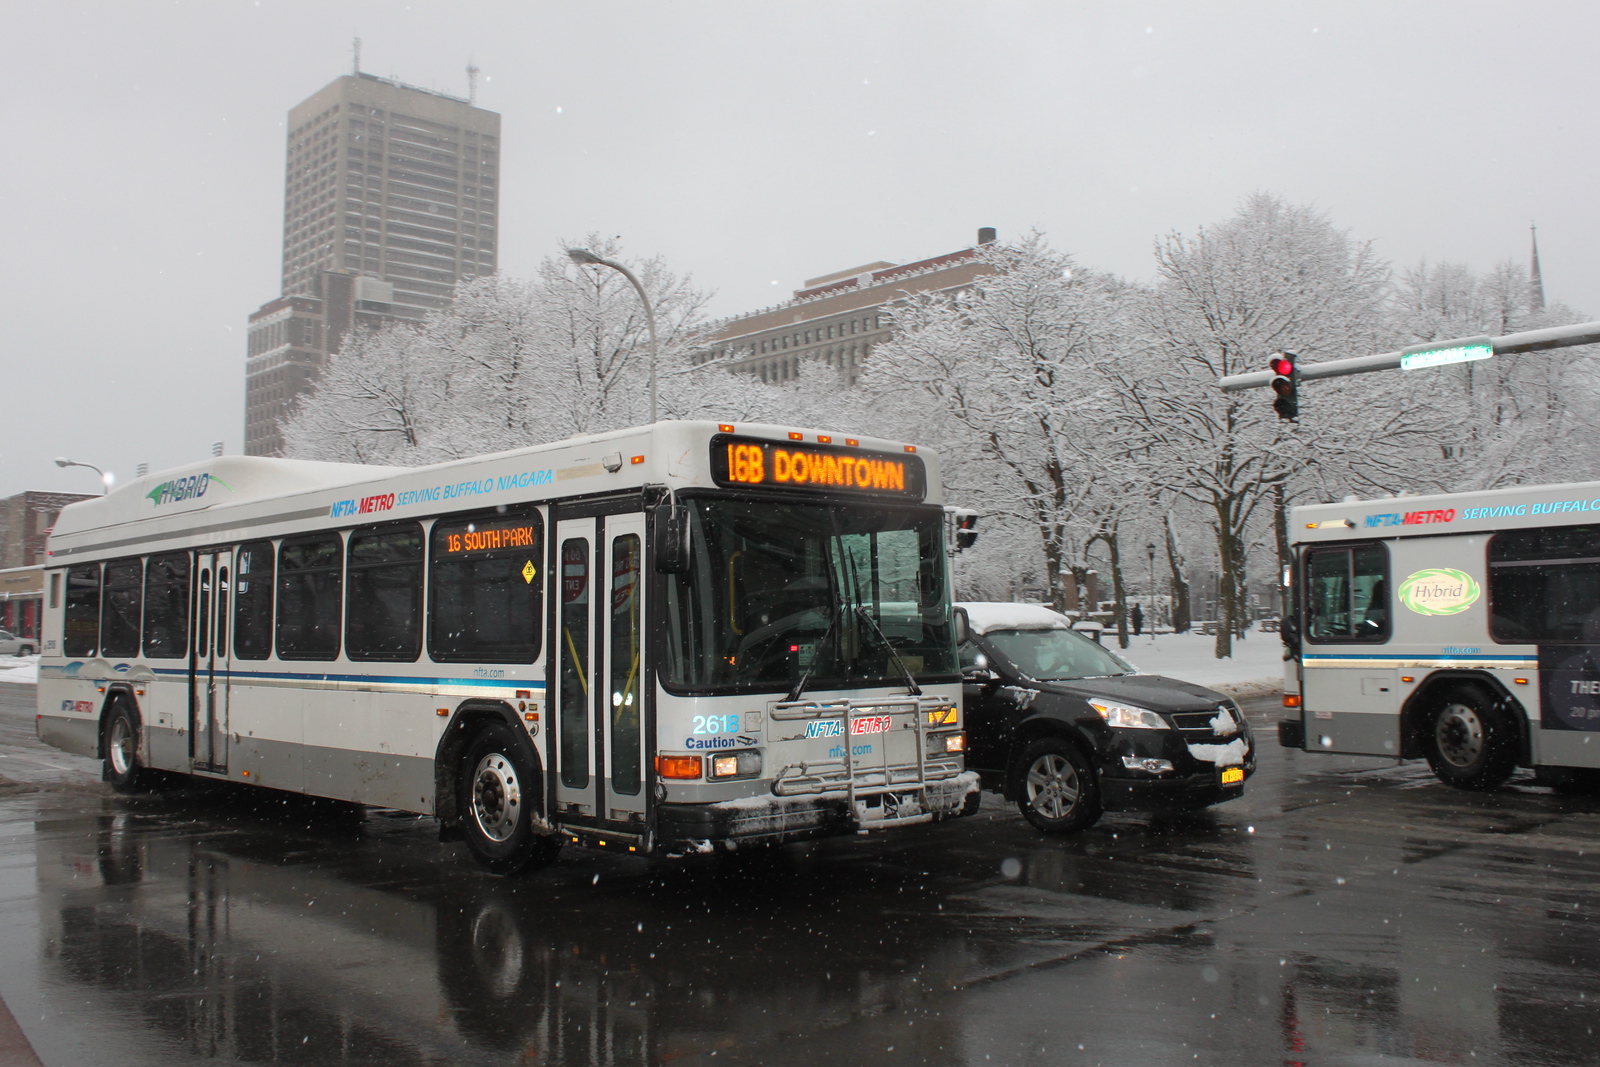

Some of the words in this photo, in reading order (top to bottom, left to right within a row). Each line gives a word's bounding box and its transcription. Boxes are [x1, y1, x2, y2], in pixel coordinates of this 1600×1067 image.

[727, 443, 764, 484] 16B
[773, 449, 905, 491] DOWNTOWN
[157, 472, 209, 505] HYBRID
[396, 486, 441, 506] SERVING
[442, 478, 494, 500] BUFFALO
[496, 469, 553, 491] NIAGARA
[1462, 504, 1527, 520] SERVING
[447, 534, 461, 552] 16
[464, 530, 501, 551] SOUTH
[502, 526, 534, 547] PARK
[1415, 583, 1463, 603] Hybrid
[1442, 646, 1480, 654] nfta.com
[473, 667, 505, 678] nfta.com
[692, 714, 740, 735] 2618
[685, 736, 736, 750] Caution
